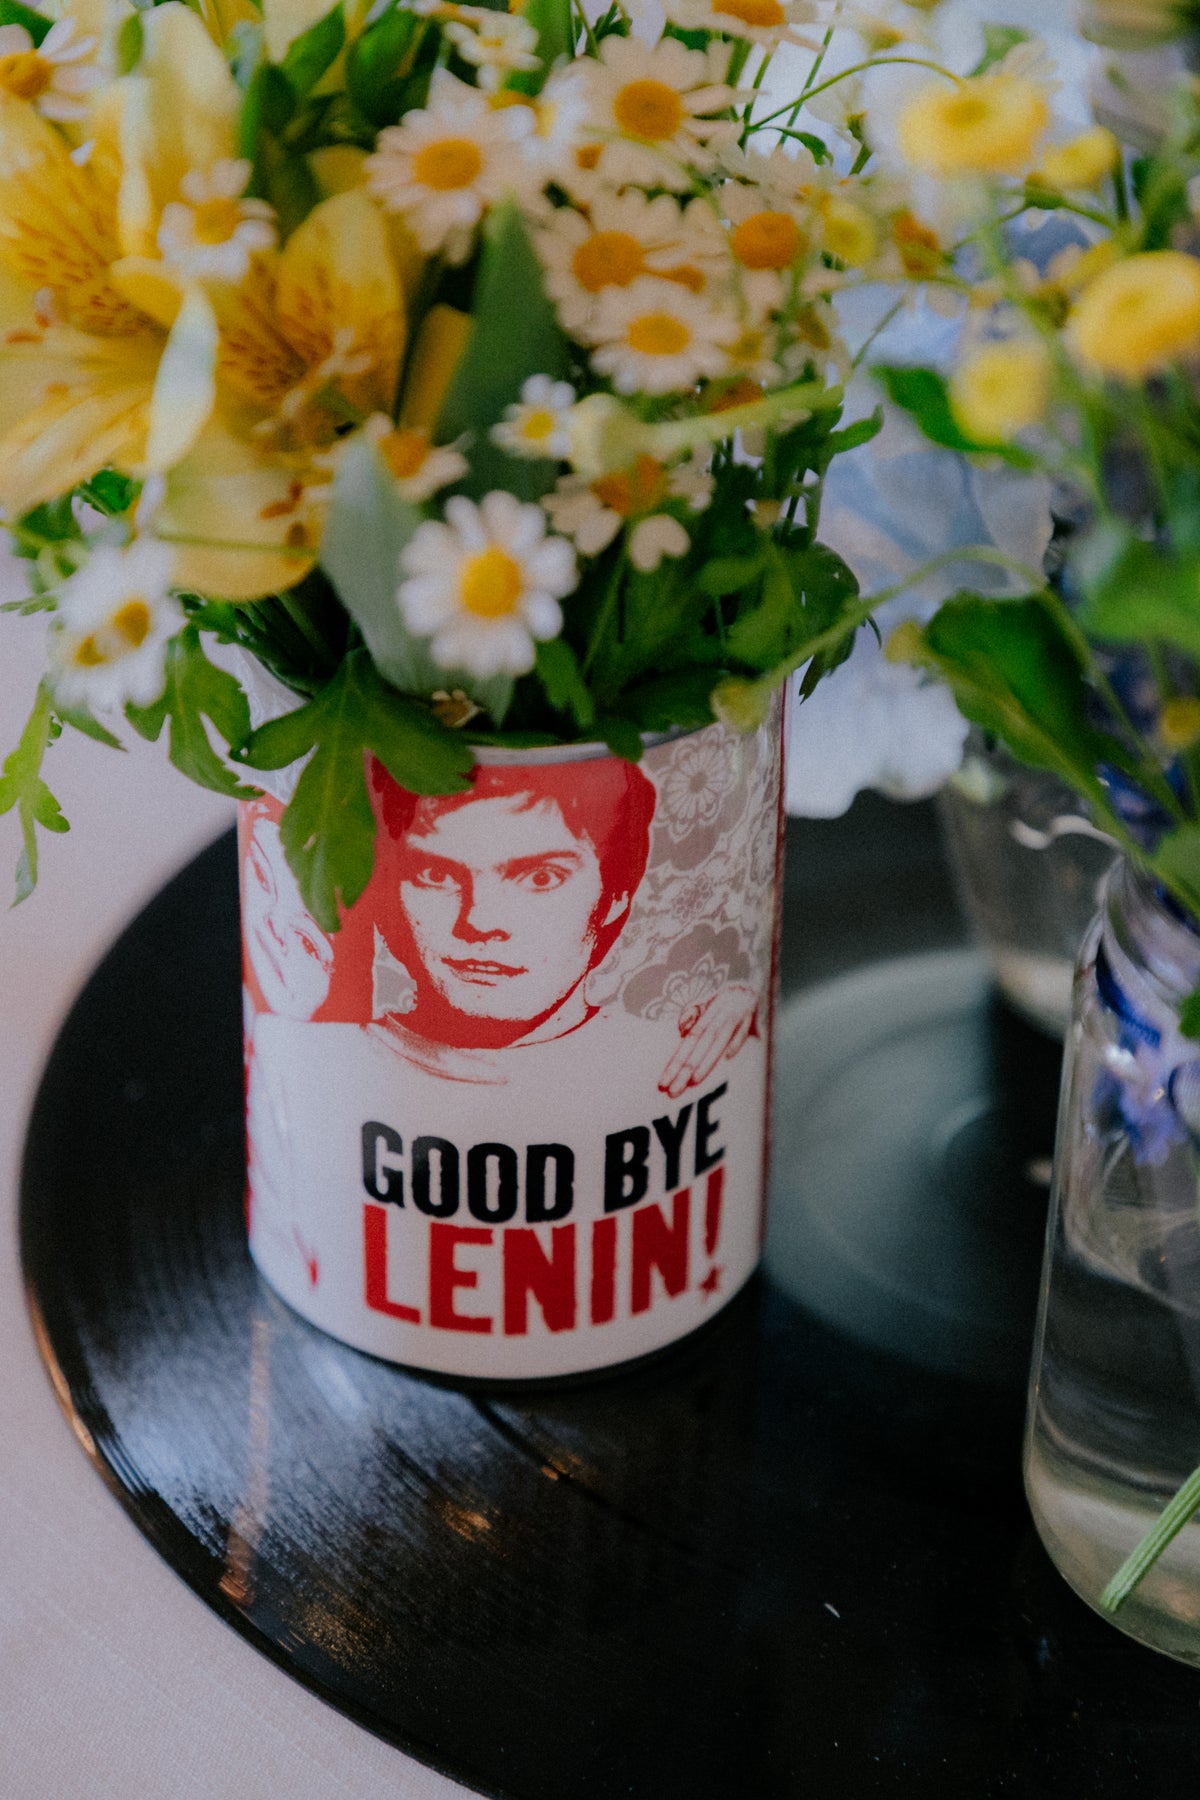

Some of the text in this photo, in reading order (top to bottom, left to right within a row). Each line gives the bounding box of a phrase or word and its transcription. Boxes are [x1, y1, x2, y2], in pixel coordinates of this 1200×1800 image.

[361, 1081, 728, 1224] GOOD BYE
[362, 1166, 725, 1335] LENIN!
